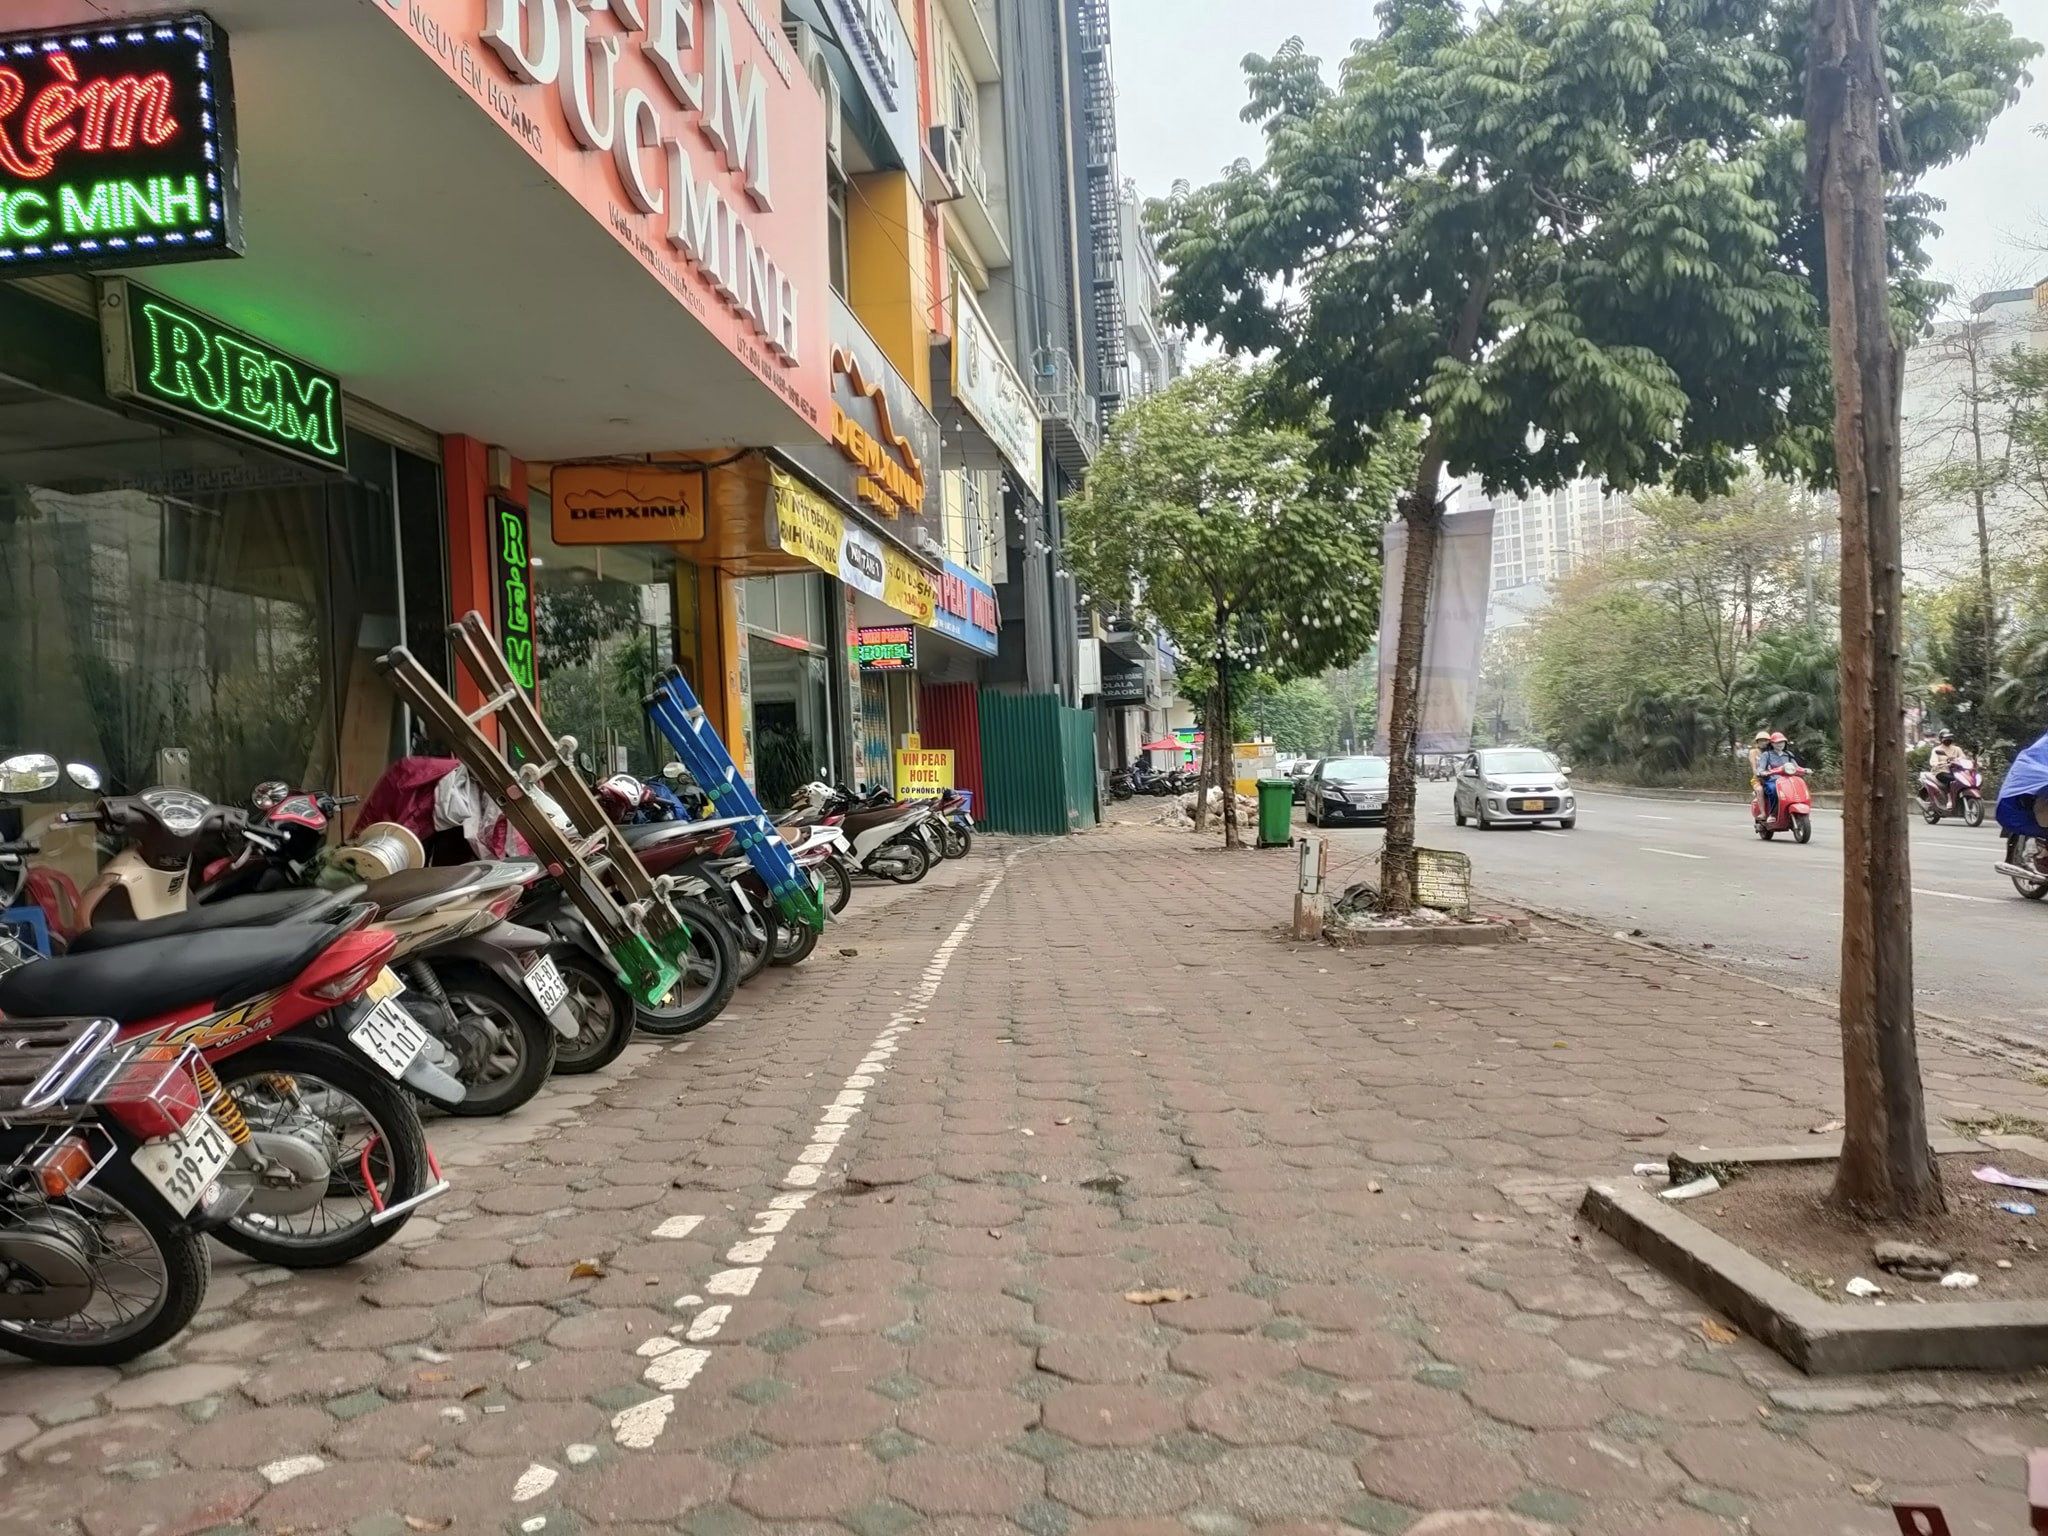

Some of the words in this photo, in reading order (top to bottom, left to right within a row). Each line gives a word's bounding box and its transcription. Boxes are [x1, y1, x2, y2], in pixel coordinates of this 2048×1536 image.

[487, 78, 543, 154] HOÀNG
[60, 175, 200, 233] MINH
[664, 136, 800, 368] MINH
[570, 505, 686, 520] DEMXINH
[860, 643, 912, 661] HOTEL
[902, 752, 919, 766] VIN
[921, 752, 947, 766] PEAR
[910, 769, 939, 782] HOTEL
[531, 961, 556, 992] 29-B1
